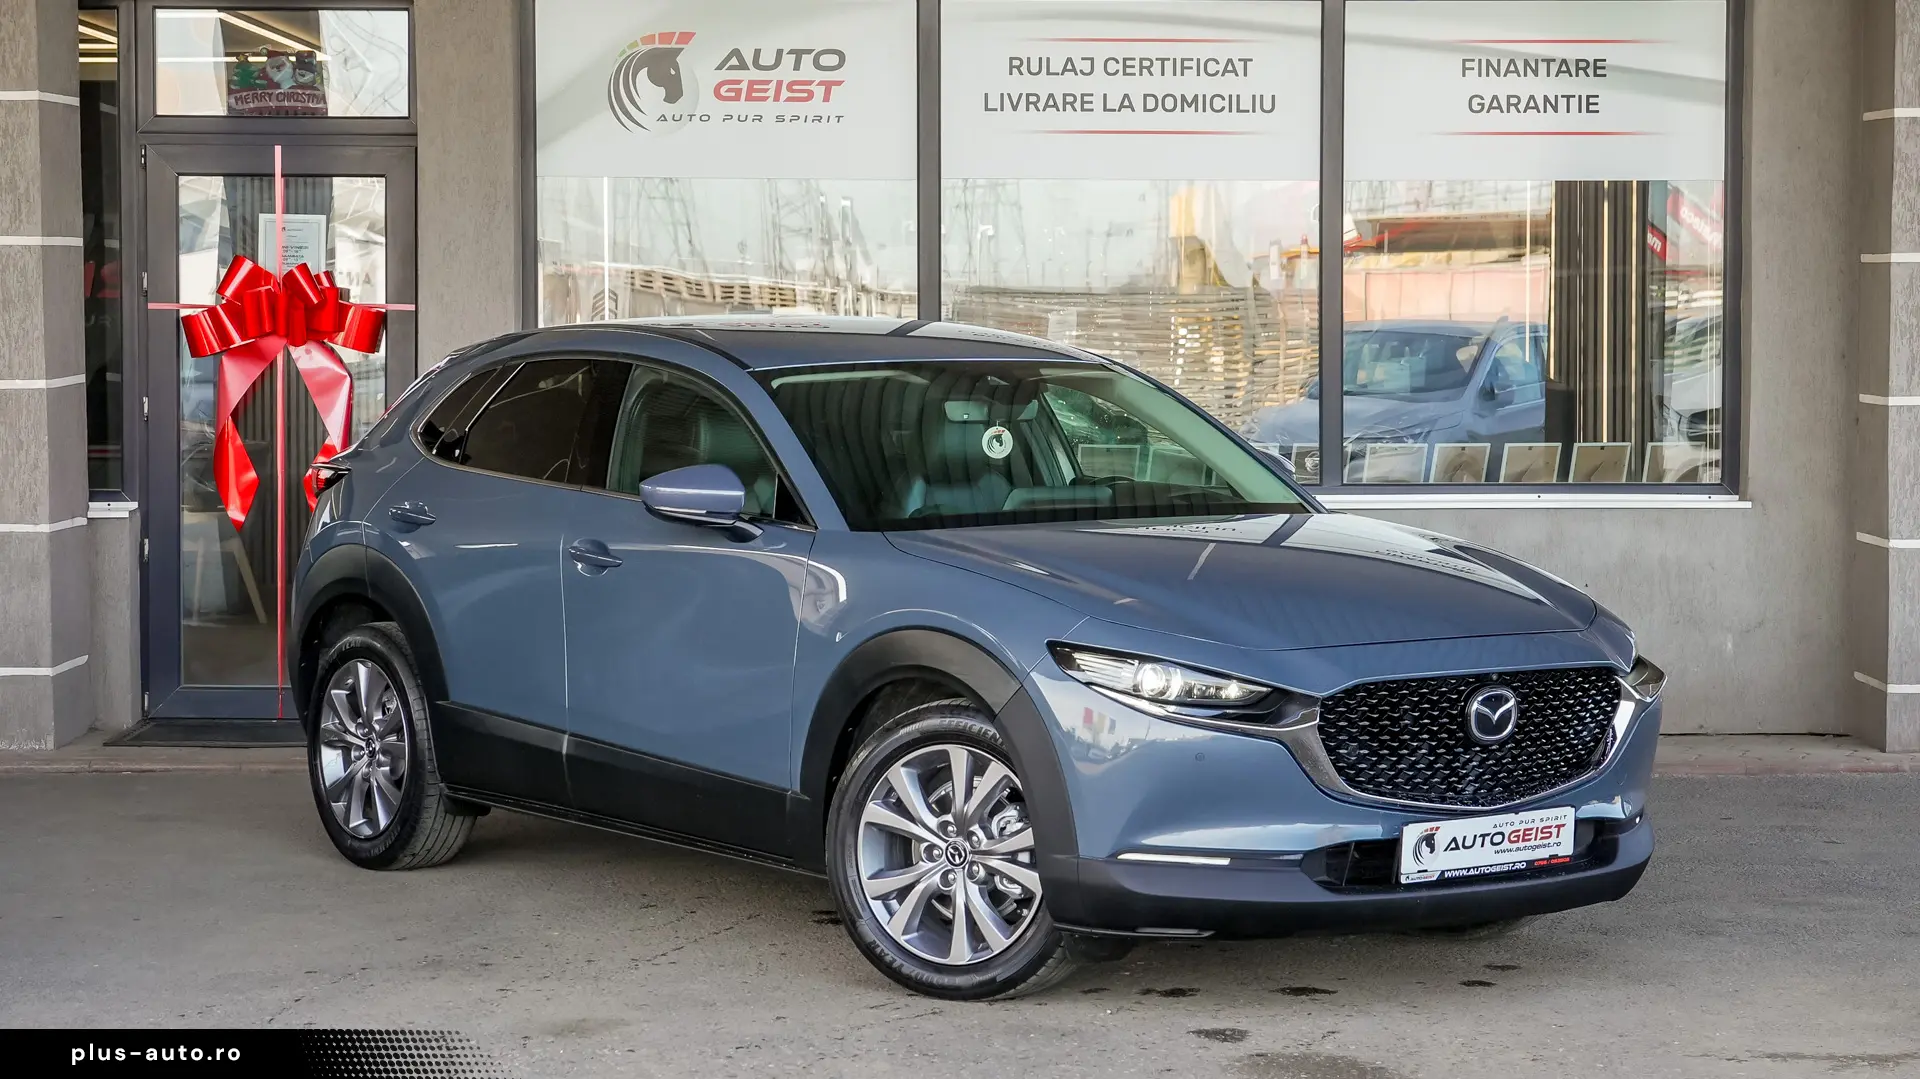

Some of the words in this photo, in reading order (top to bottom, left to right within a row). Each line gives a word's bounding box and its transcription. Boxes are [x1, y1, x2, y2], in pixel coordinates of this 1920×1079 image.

[714, 48, 846, 71] AUTO
[1008, 57, 1095, 76] RULAJ
[1102, 57, 1254, 77] CERTIFICAT
[1461, 58, 1608, 78] FINANTARE
[233, 91, 273, 106] MERRY
[713, 80, 845, 102] GEIST
[984, 93, 1095, 112] LIVRARE
[1102, 94, 1136, 112] LA
[1142, 94, 1276, 113] DOMICILIU
[1468, 94, 1600, 114] GARANTIE
[656, 114, 711, 123] AUTO
[722, 114, 763, 123] PUR
[775, 115, 844, 124] SPIRIT
[1493, 821, 1515, 829] AUTO
[1540, 815, 1567, 823] SPIRIT
[1494, 841, 1561, 855] www.autogeist.ro
[1444, 861, 1527, 878] WWW.AUTOGEIST.RO
